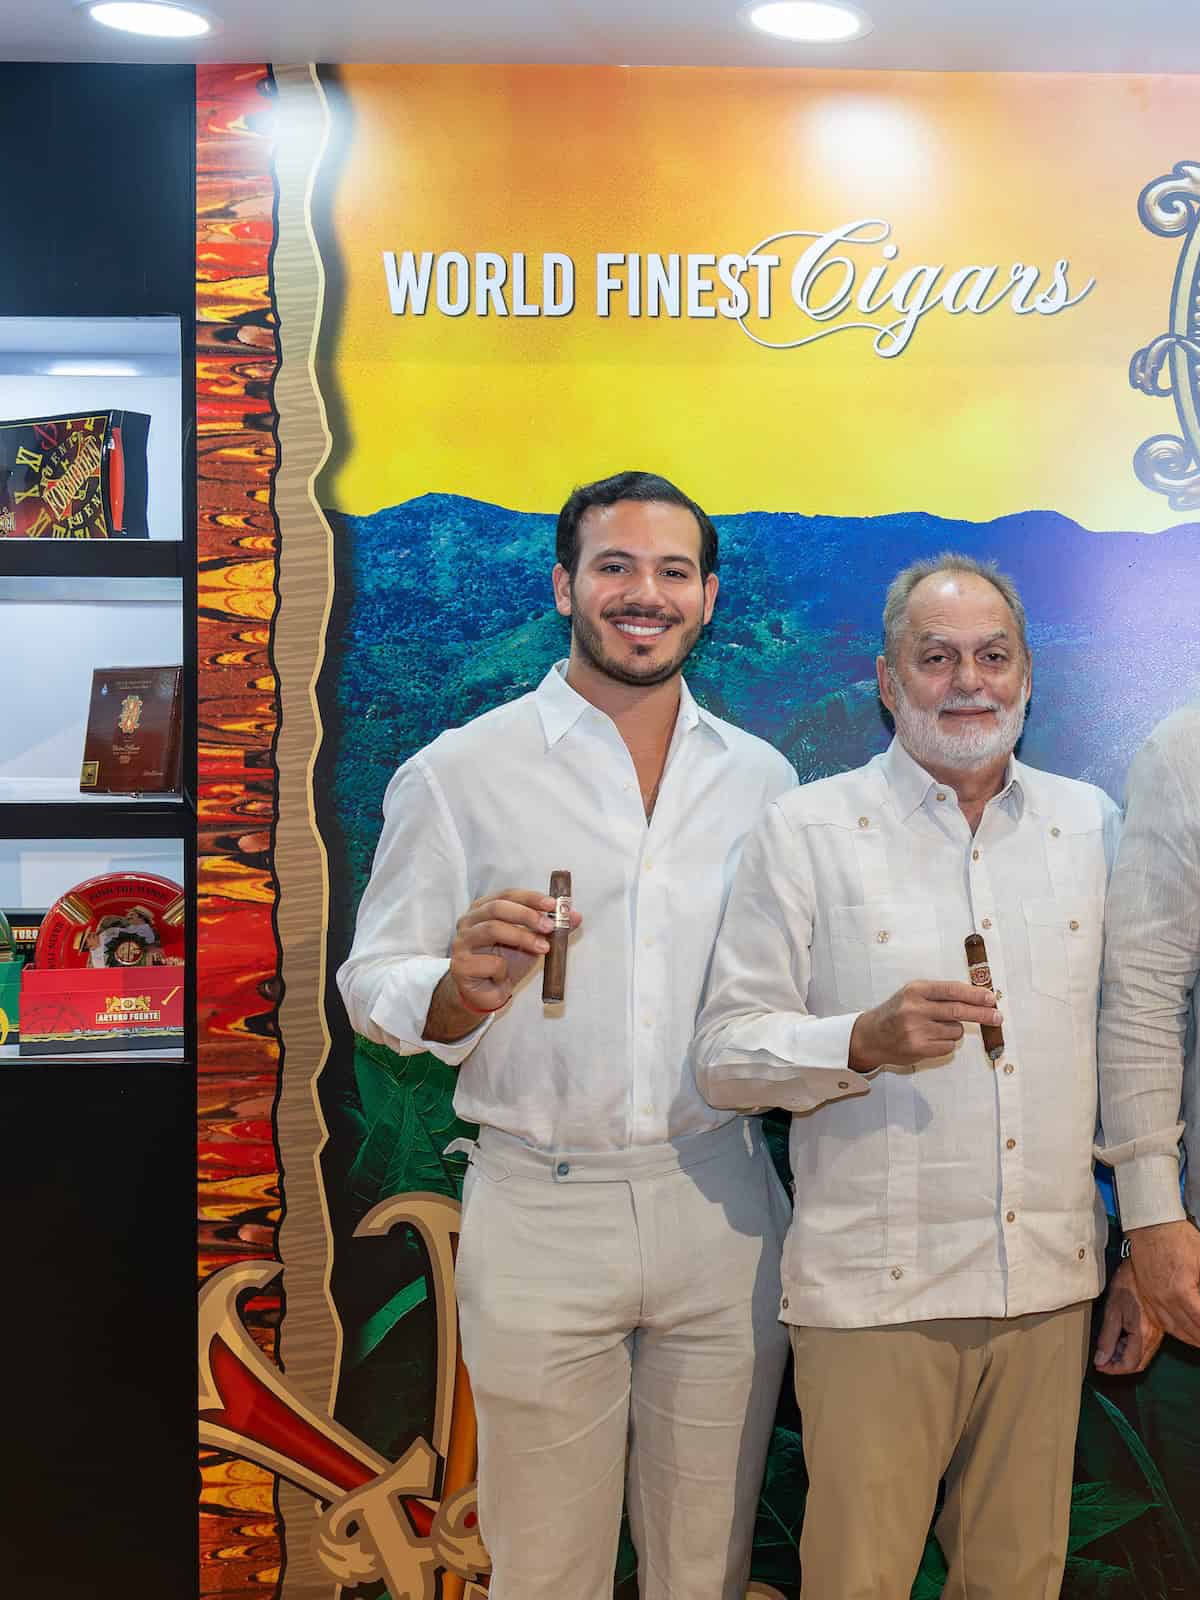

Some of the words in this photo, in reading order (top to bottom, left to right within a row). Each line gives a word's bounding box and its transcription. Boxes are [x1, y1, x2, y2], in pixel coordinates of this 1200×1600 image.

[382, 251, 576, 317] WORLD
[596, 252, 781, 318] FINEST
[737, 218, 1096, 358] Cigars
[98, 1013, 128, 1022] ARTURO
[130, 1012, 160, 1021] FUENTE
